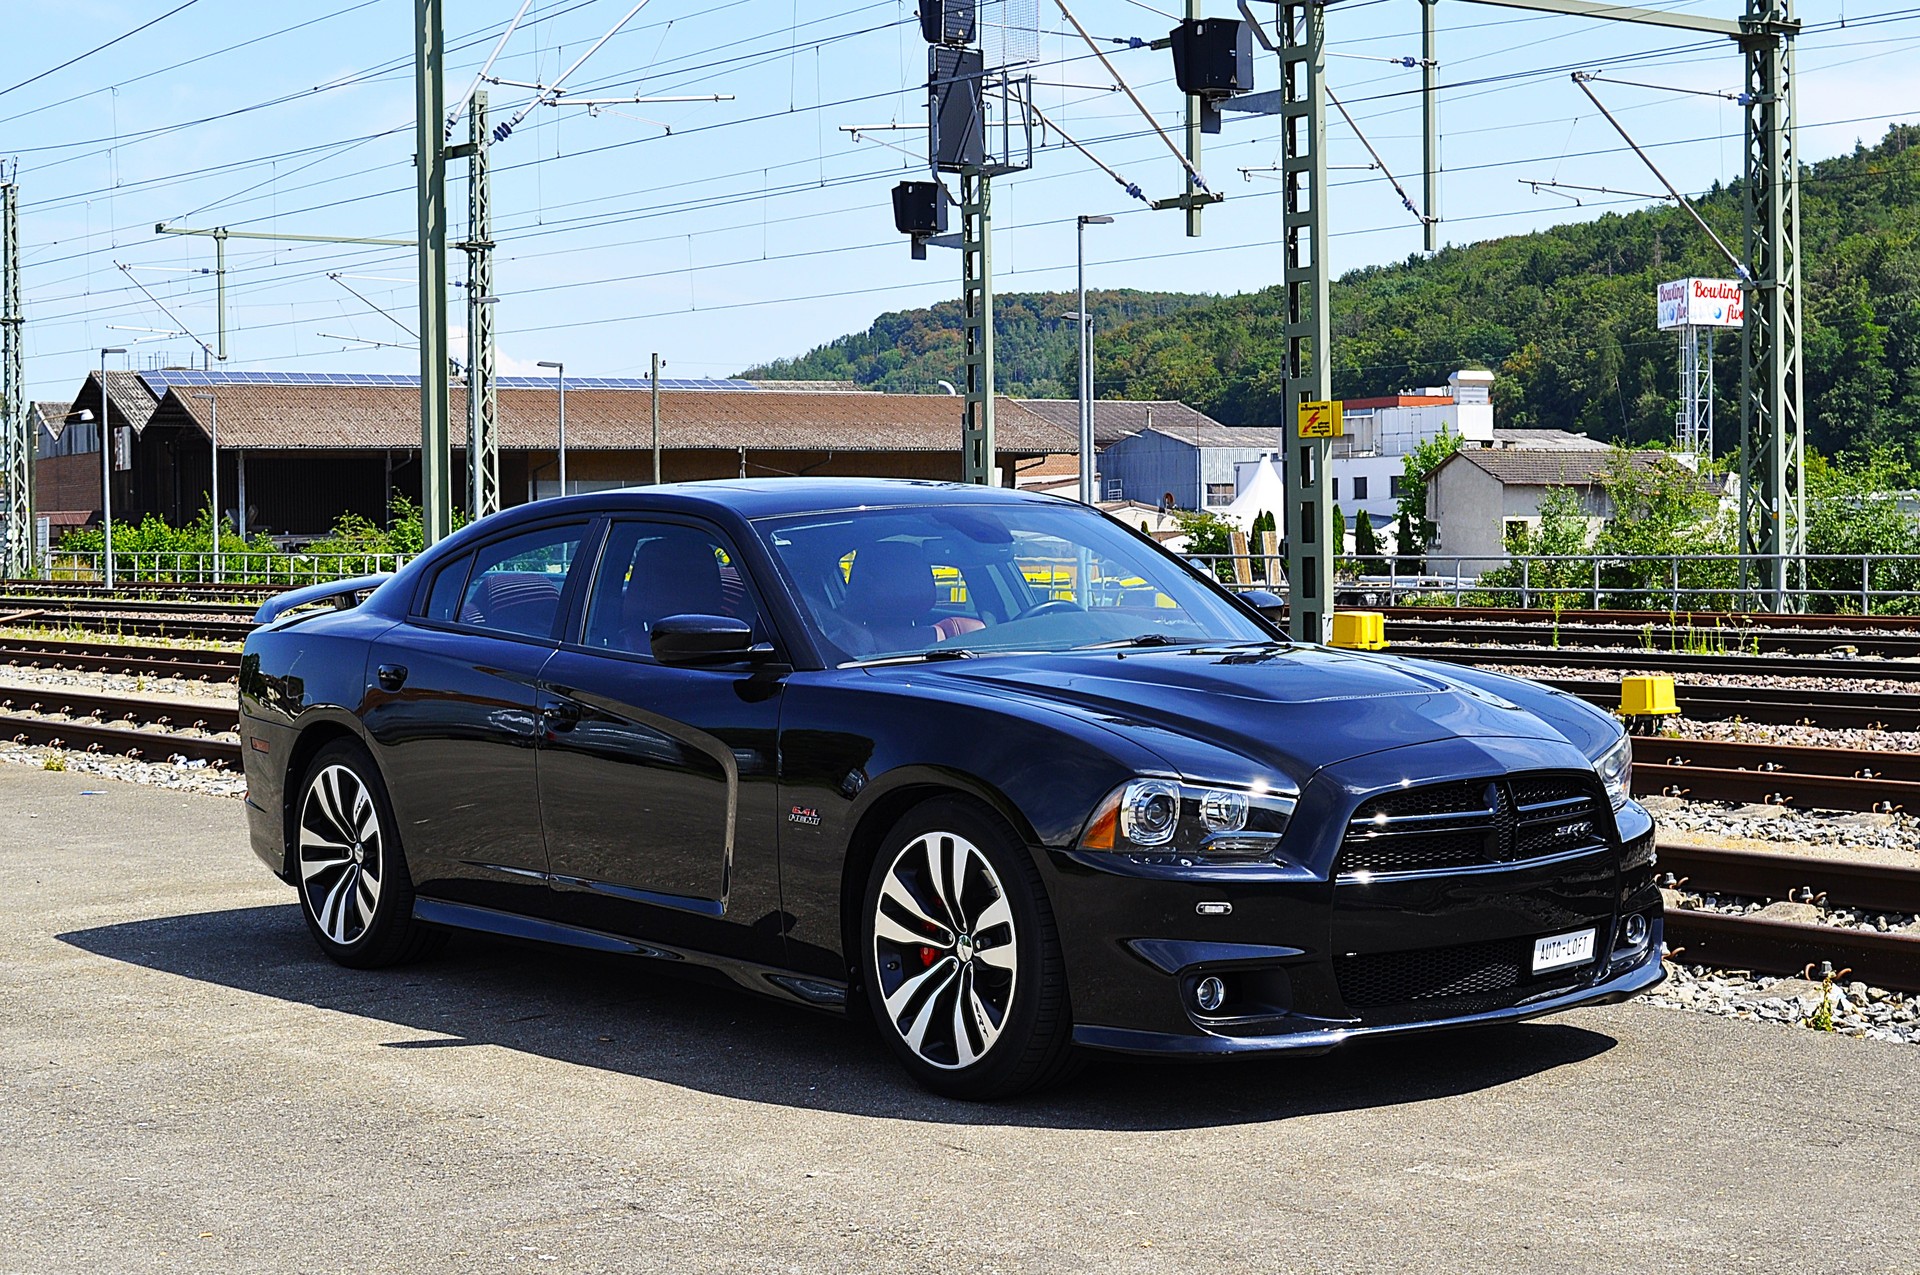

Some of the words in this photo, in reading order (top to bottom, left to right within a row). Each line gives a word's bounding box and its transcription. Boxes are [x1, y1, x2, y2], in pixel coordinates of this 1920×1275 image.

[1660, 283, 1685, 303] Bowling
[1694, 281, 1740, 305] Bowling
[1540, 936, 1588, 961] AUTO-LOFT
